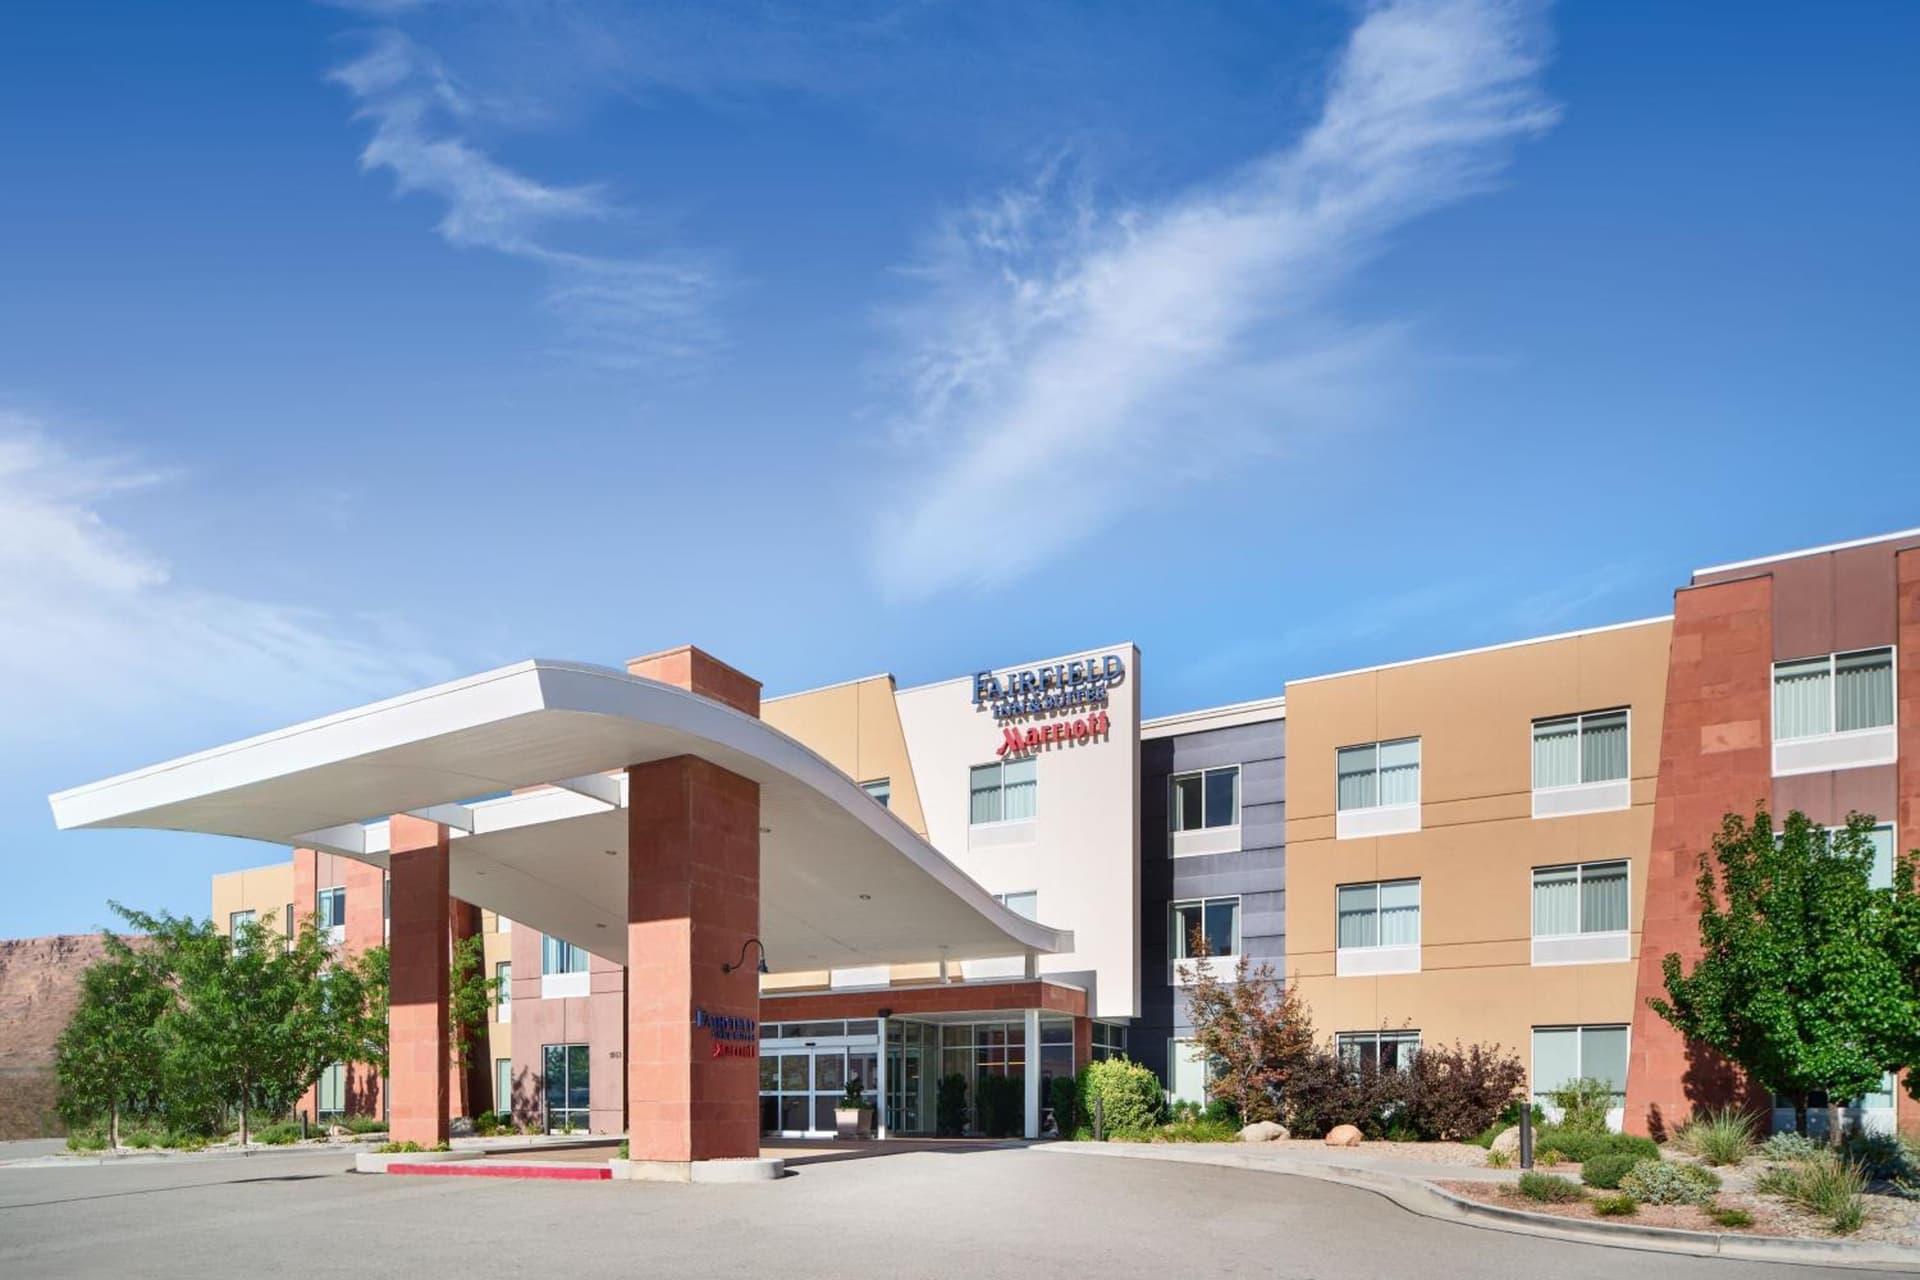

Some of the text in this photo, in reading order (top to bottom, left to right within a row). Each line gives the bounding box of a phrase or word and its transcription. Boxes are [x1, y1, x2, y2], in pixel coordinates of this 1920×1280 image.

[971, 655, 1124, 704] FAIRFIELD
[993, 701, 1027, 719] INN
[1029, 698, 1043, 713] &
[996, 711, 1109, 756] Marriott
